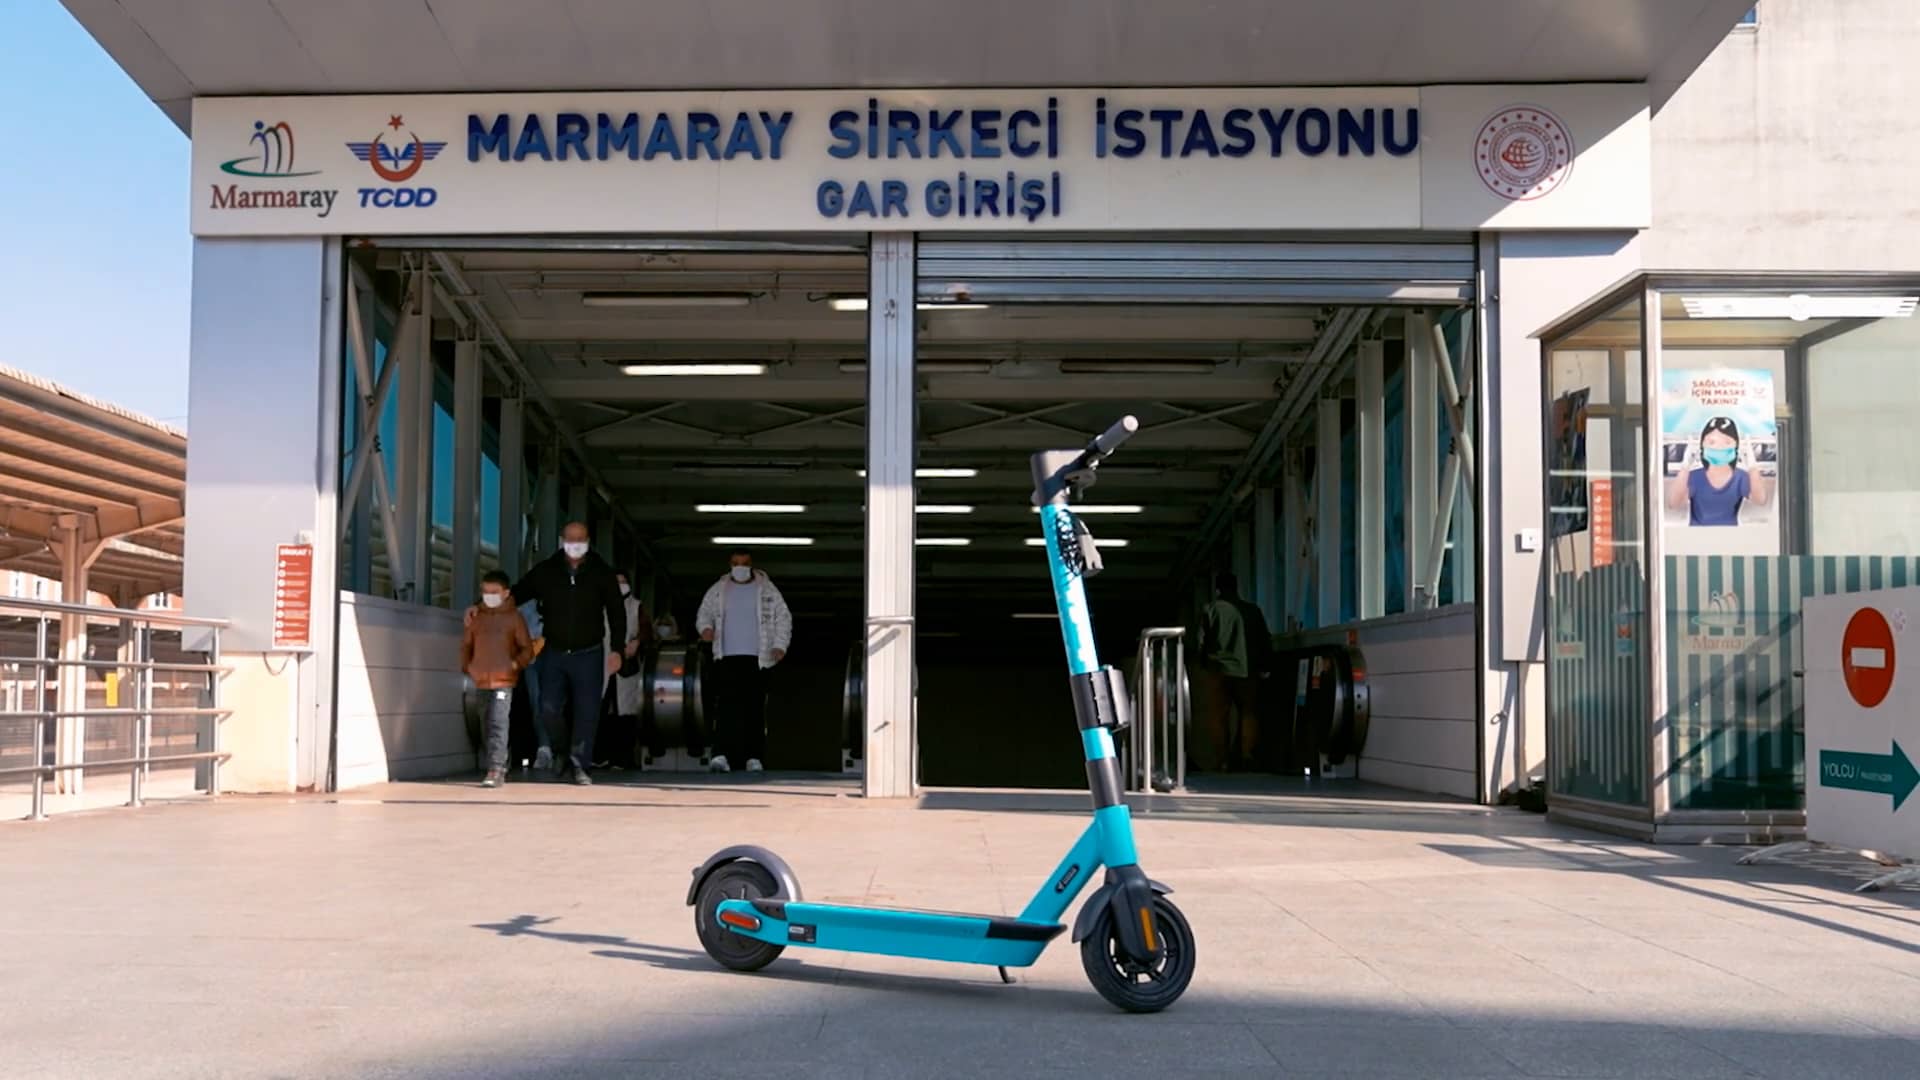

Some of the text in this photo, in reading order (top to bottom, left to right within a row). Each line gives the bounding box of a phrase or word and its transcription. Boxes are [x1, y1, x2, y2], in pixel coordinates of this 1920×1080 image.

[466, 111, 794, 162] MARMARAY
[827, 97, 1059, 160] SİRKECİ
[1096, 97, 1419, 159] İSTASYONU
[210, 184, 338, 218] Marmaray
[357, 188, 437, 208] TCDD
[816, 171, 1061, 222] GAR GİRİŞİ
[1823, 762, 1855, 779] YOLCU
